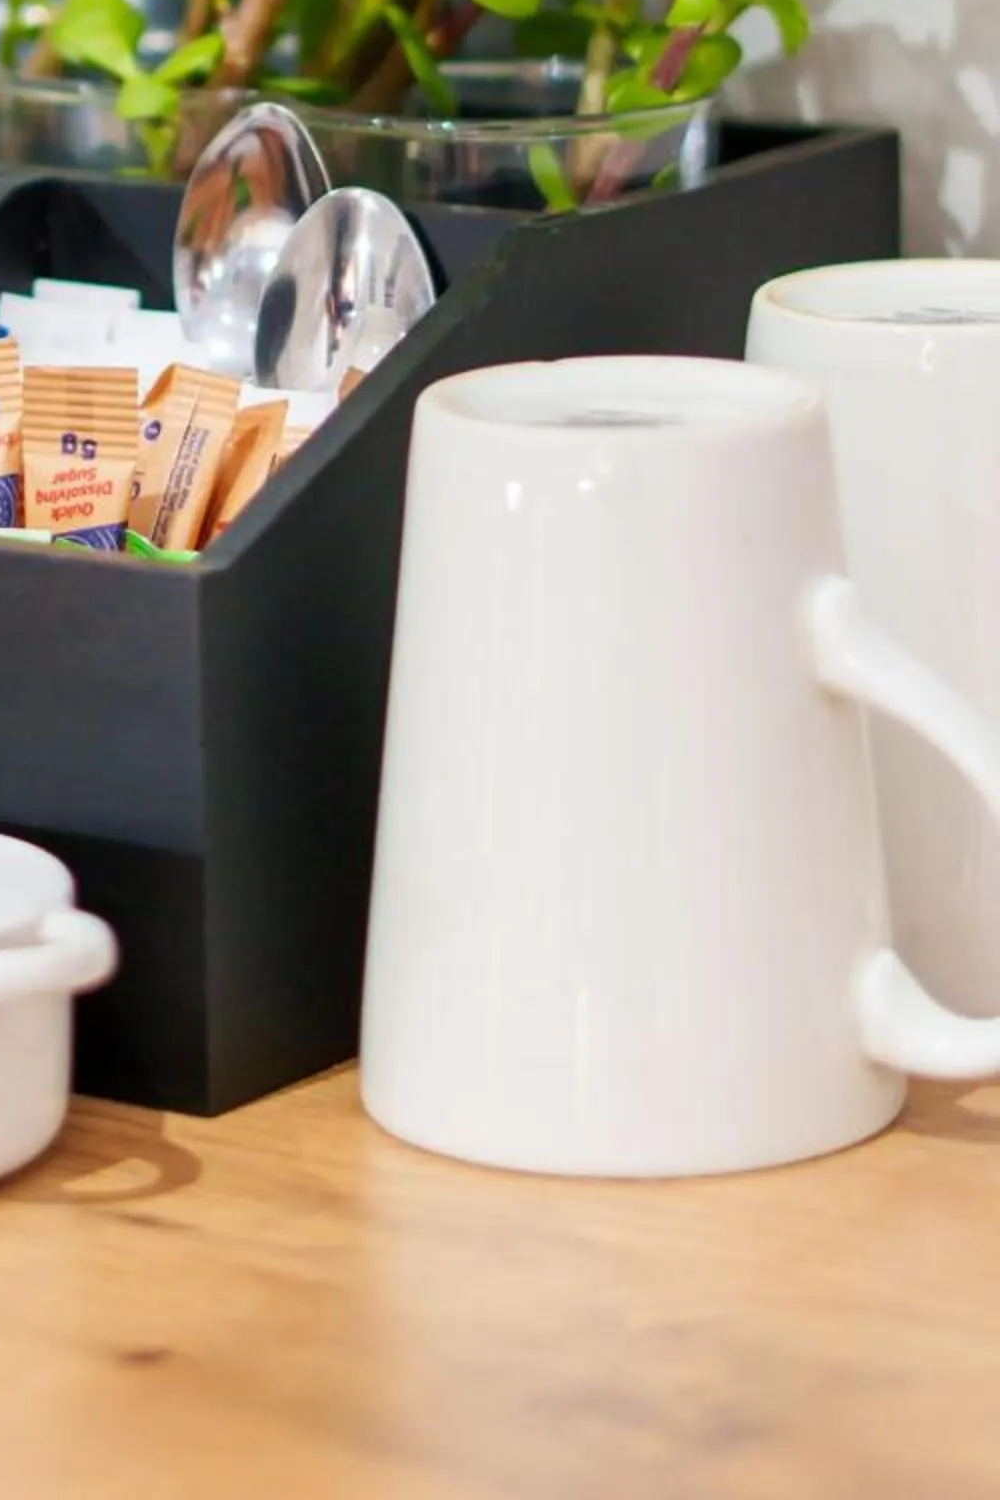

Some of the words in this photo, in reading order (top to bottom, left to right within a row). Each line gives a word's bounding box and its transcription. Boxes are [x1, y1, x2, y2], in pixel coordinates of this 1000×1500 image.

[61, 433, 98, 460] 5g
[52, 467, 97, 485] Sugar
[35, 480, 112, 505] Dissolving
[51, 502, 95, 522] Quick
